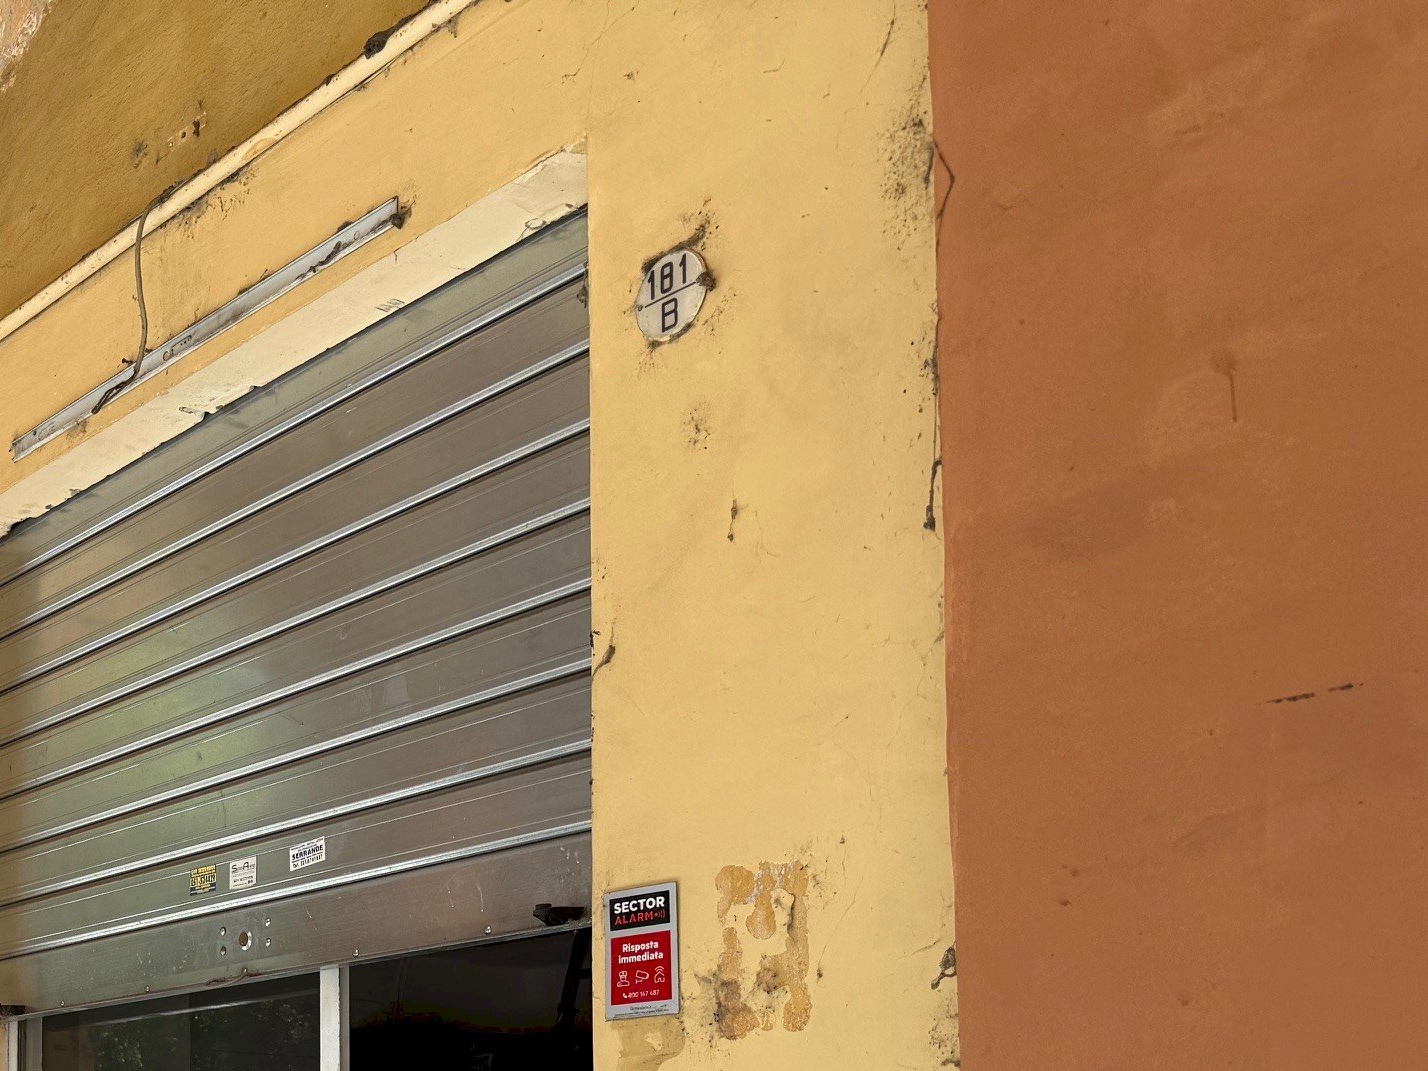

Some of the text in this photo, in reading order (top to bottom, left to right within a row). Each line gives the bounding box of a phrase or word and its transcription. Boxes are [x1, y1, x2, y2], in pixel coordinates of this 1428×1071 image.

[647, 253, 687, 300] 181
[661, 297, 678, 333] B
[291, 844, 324, 860] SERRANDE
[613, 896, 665, 914] SECTOR
[614, 911, 653, 926] ALARM
[622, 940, 659, 953] Risposta
[618, 951, 664, 964] immediata
